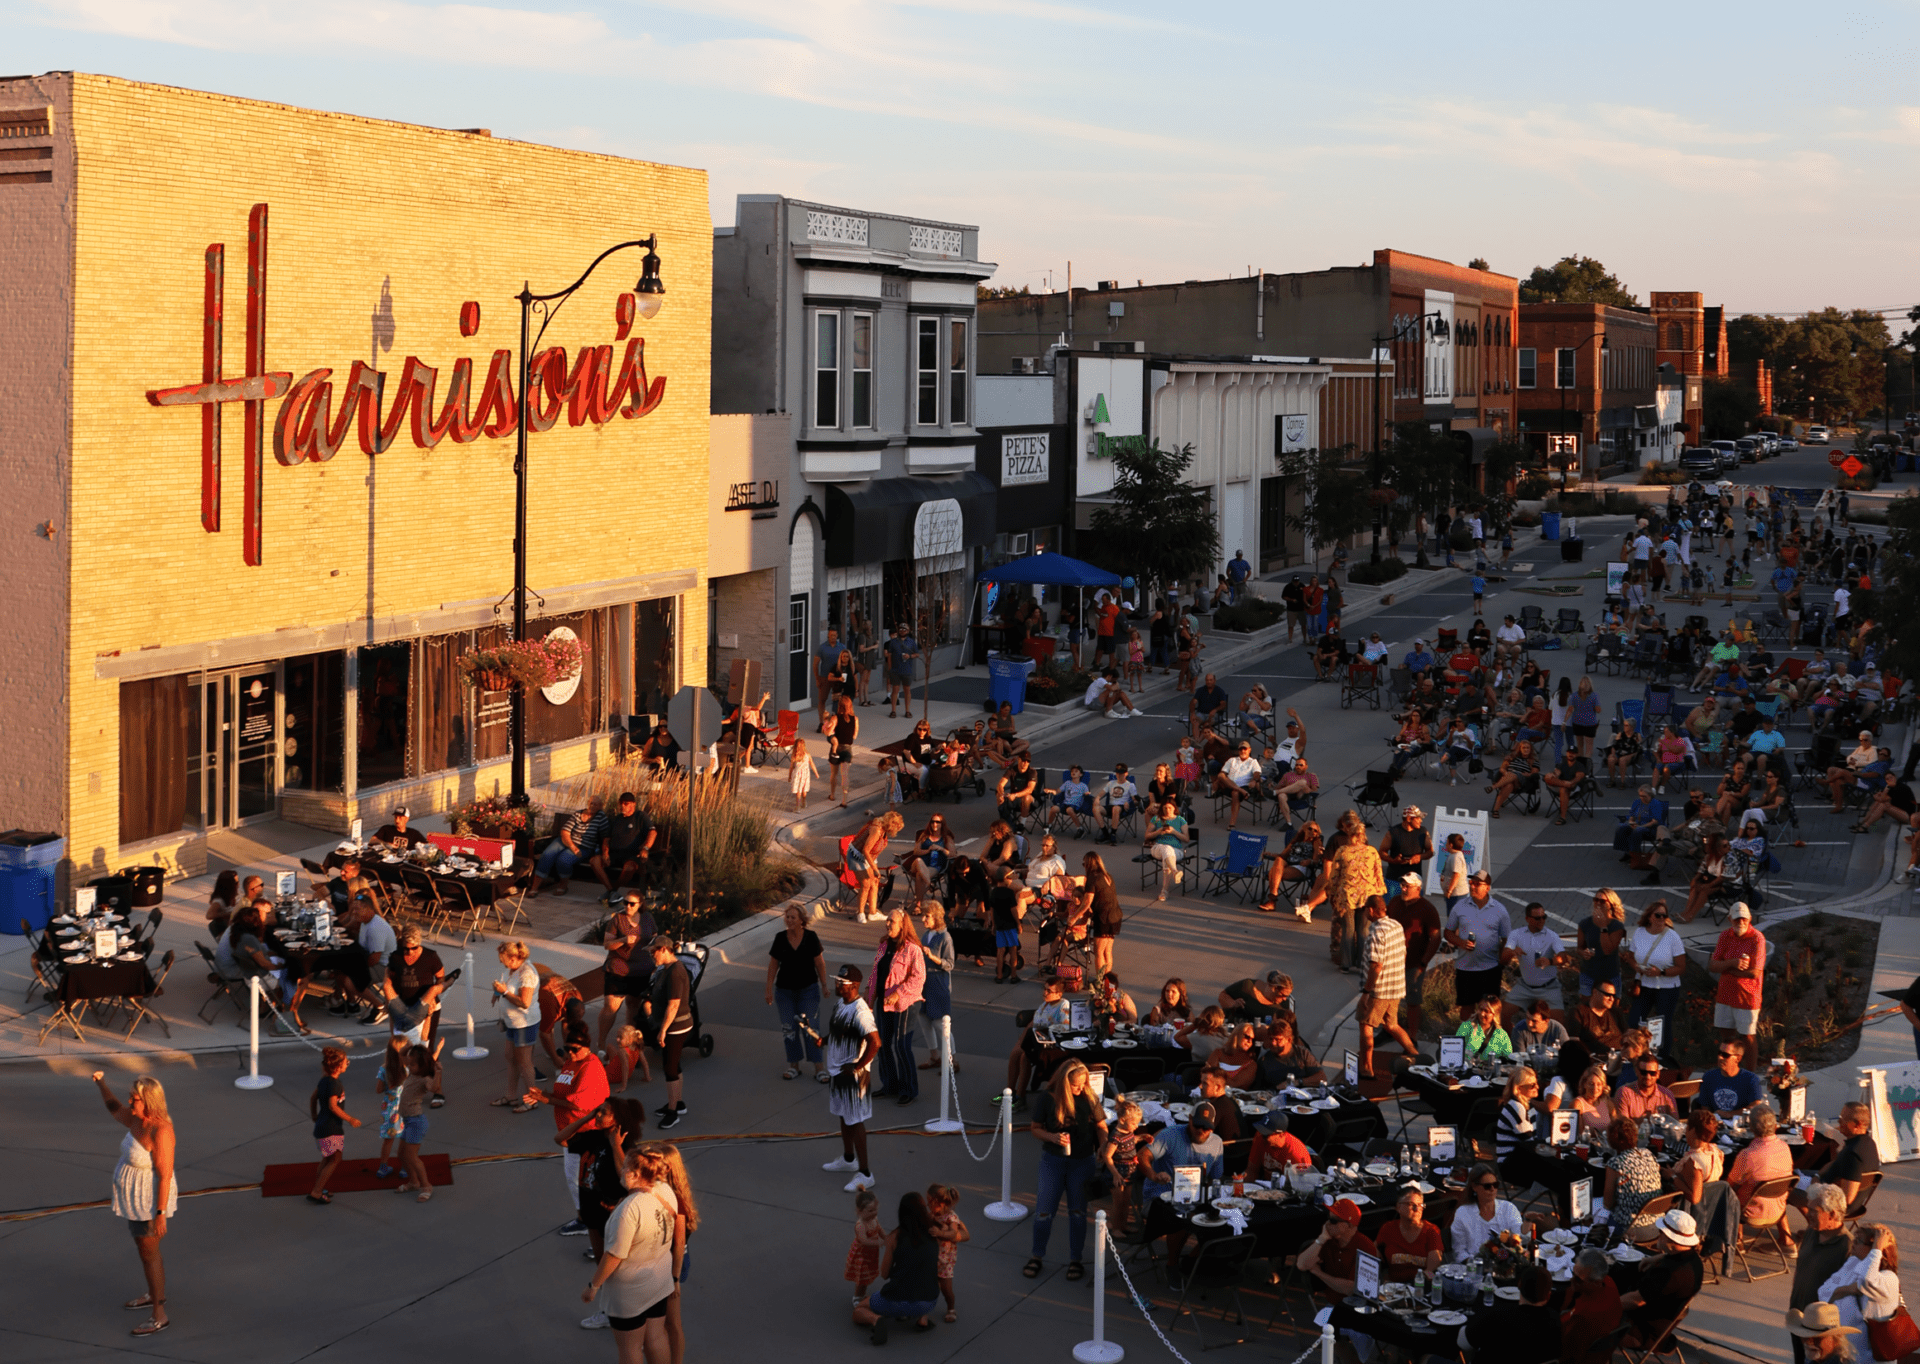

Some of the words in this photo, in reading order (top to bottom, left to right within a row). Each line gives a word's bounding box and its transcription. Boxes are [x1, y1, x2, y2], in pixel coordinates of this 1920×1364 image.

[146, 203, 667, 566] Harrison's
[1005, 436, 1046, 456] PETE'S
[1008, 455, 1043, 476] PIZZA
